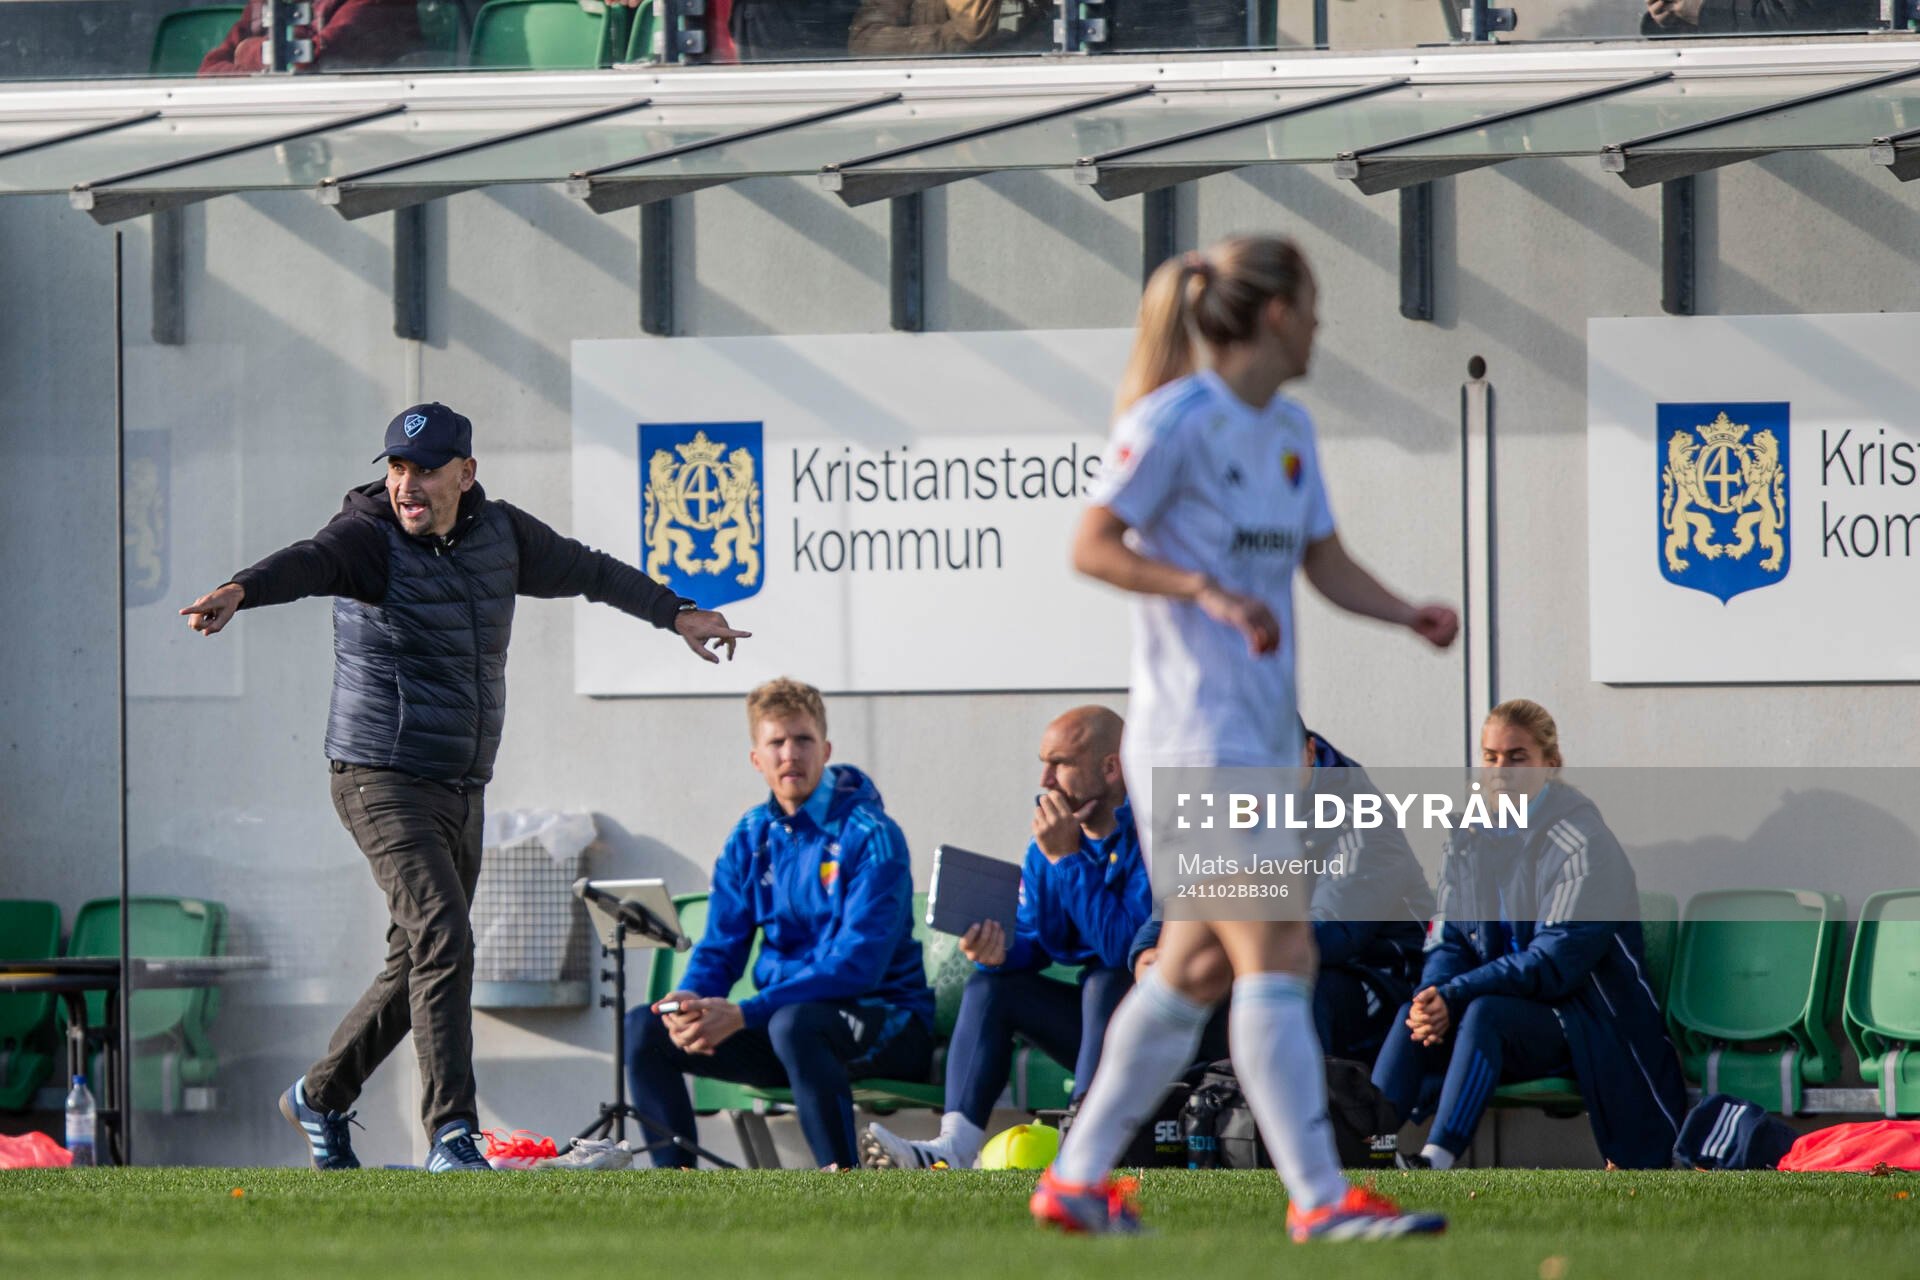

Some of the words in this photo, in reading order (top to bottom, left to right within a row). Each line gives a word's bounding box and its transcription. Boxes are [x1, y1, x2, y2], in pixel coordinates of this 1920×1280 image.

[792, 442, 1103, 503] Kristianstads
[1821, 428, 1920, 487] Kris
[793, 517, 1003, 573] kommun
